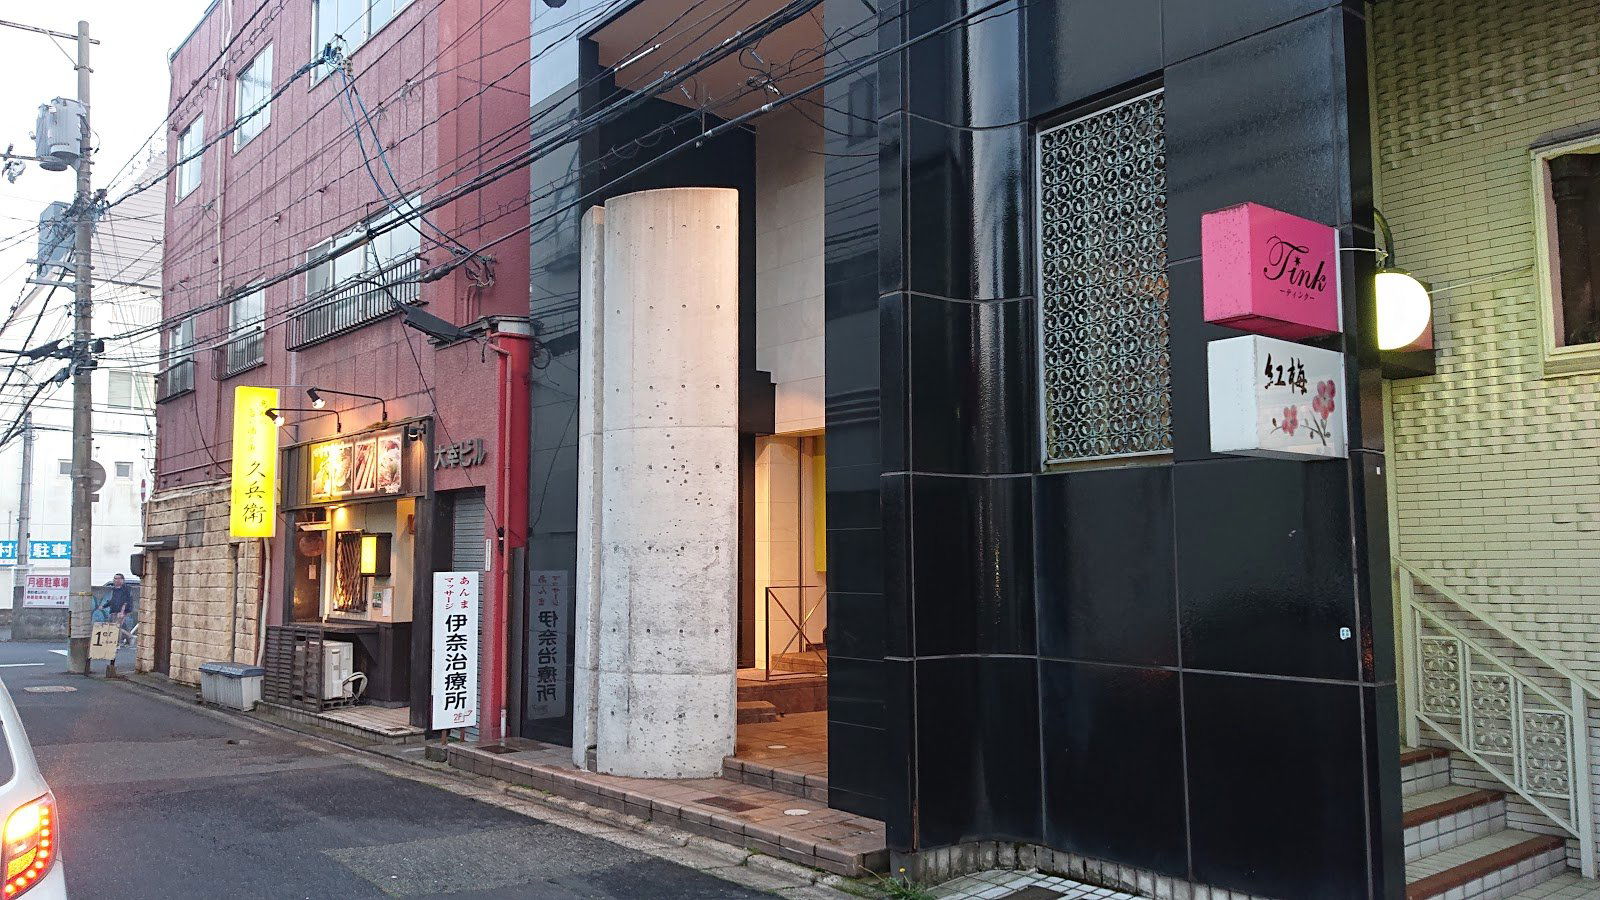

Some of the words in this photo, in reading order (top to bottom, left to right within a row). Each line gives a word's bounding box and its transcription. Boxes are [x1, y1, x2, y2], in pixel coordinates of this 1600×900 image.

[1263, 234, 1327, 292] Tink
[1264, 353, 1308, 395] 紅梅
[243, 461, 267, 523] 久兵衛
[28, 577, 69, 588] 月極駐車場
[444, 577, 454, 610] マッサージ
[459, 576, 470, 609] あんま
[444, 614, 468, 711] 伊奈治療所
[453, 713, 463, 722] 2F
